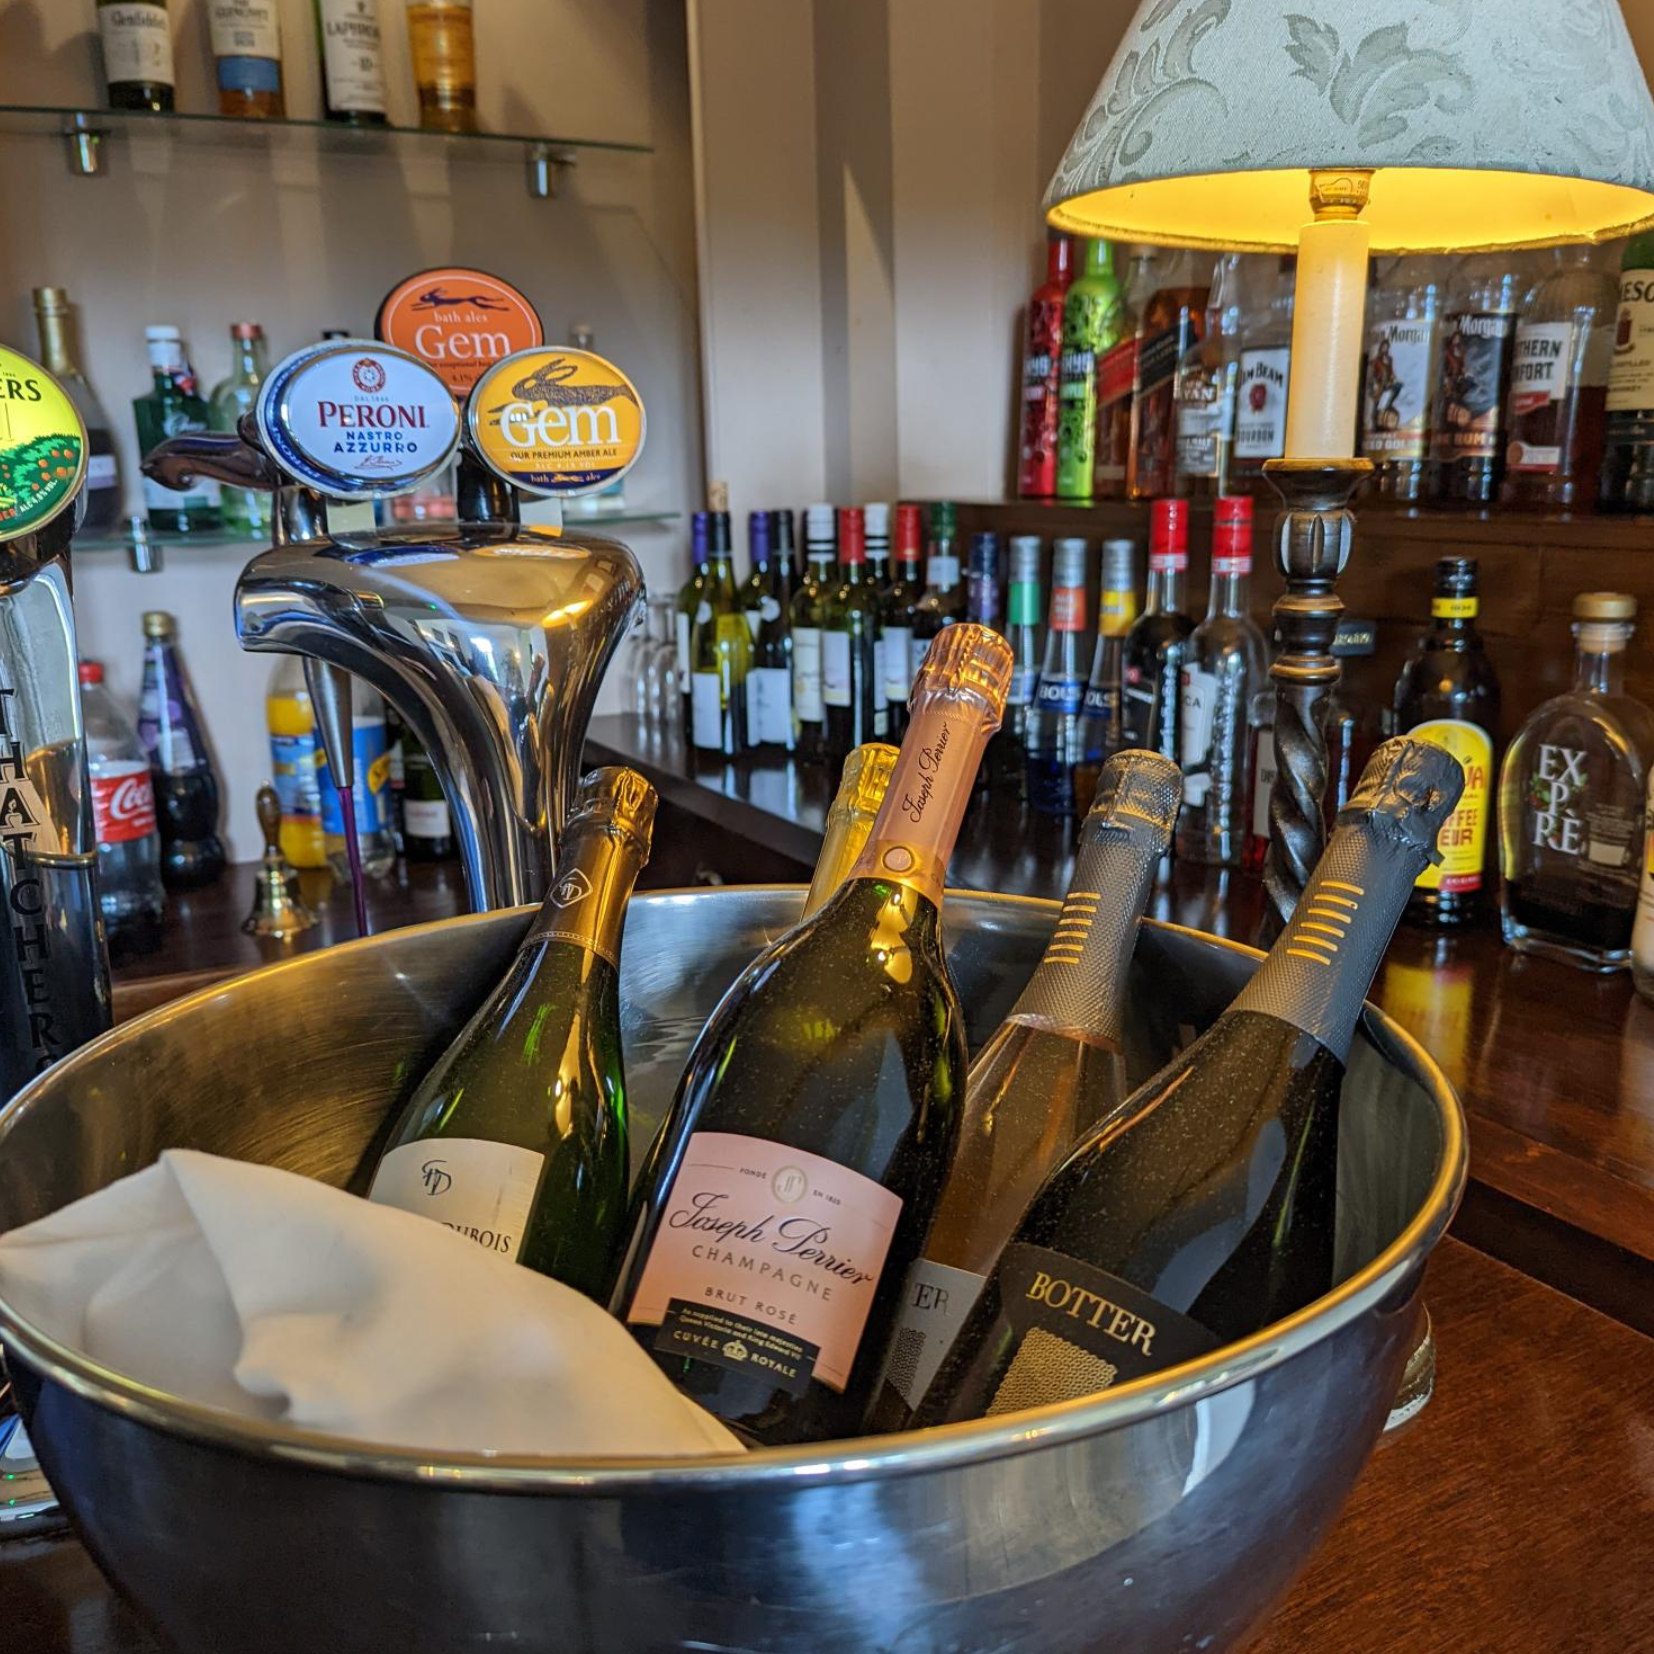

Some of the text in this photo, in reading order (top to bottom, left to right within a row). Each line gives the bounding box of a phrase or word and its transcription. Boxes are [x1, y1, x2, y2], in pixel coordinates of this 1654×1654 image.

[433, 310, 489, 323] bath ales
[415, 324, 512, 360] Gem
[318, 401, 430, 429] PERONI
[501, 402, 622, 448] Gem
[333, 442, 418, 454] AZZURRO
[346, 431, 403, 441] NASTRO
[510, 448, 618, 460] OUR PREMIUM AMBER ALE
[917, 721, 951, 774] Perrier
[902, 772, 935, 824] Joseph
[669, 1191, 874, 1286] Joseph Perrier
[691, 1244, 834, 1302] CHAMPAGNE
[704, 1286, 748, 1307] BRUT
[1025, 1270, 1157, 1356] BOTTER
[732, 1328, 748, 1341] and
[747, 1333, 764, 1347] King
[764, 1339, 790, 1357] Edward
[749, 1351, 798, 1379] ROYALE
